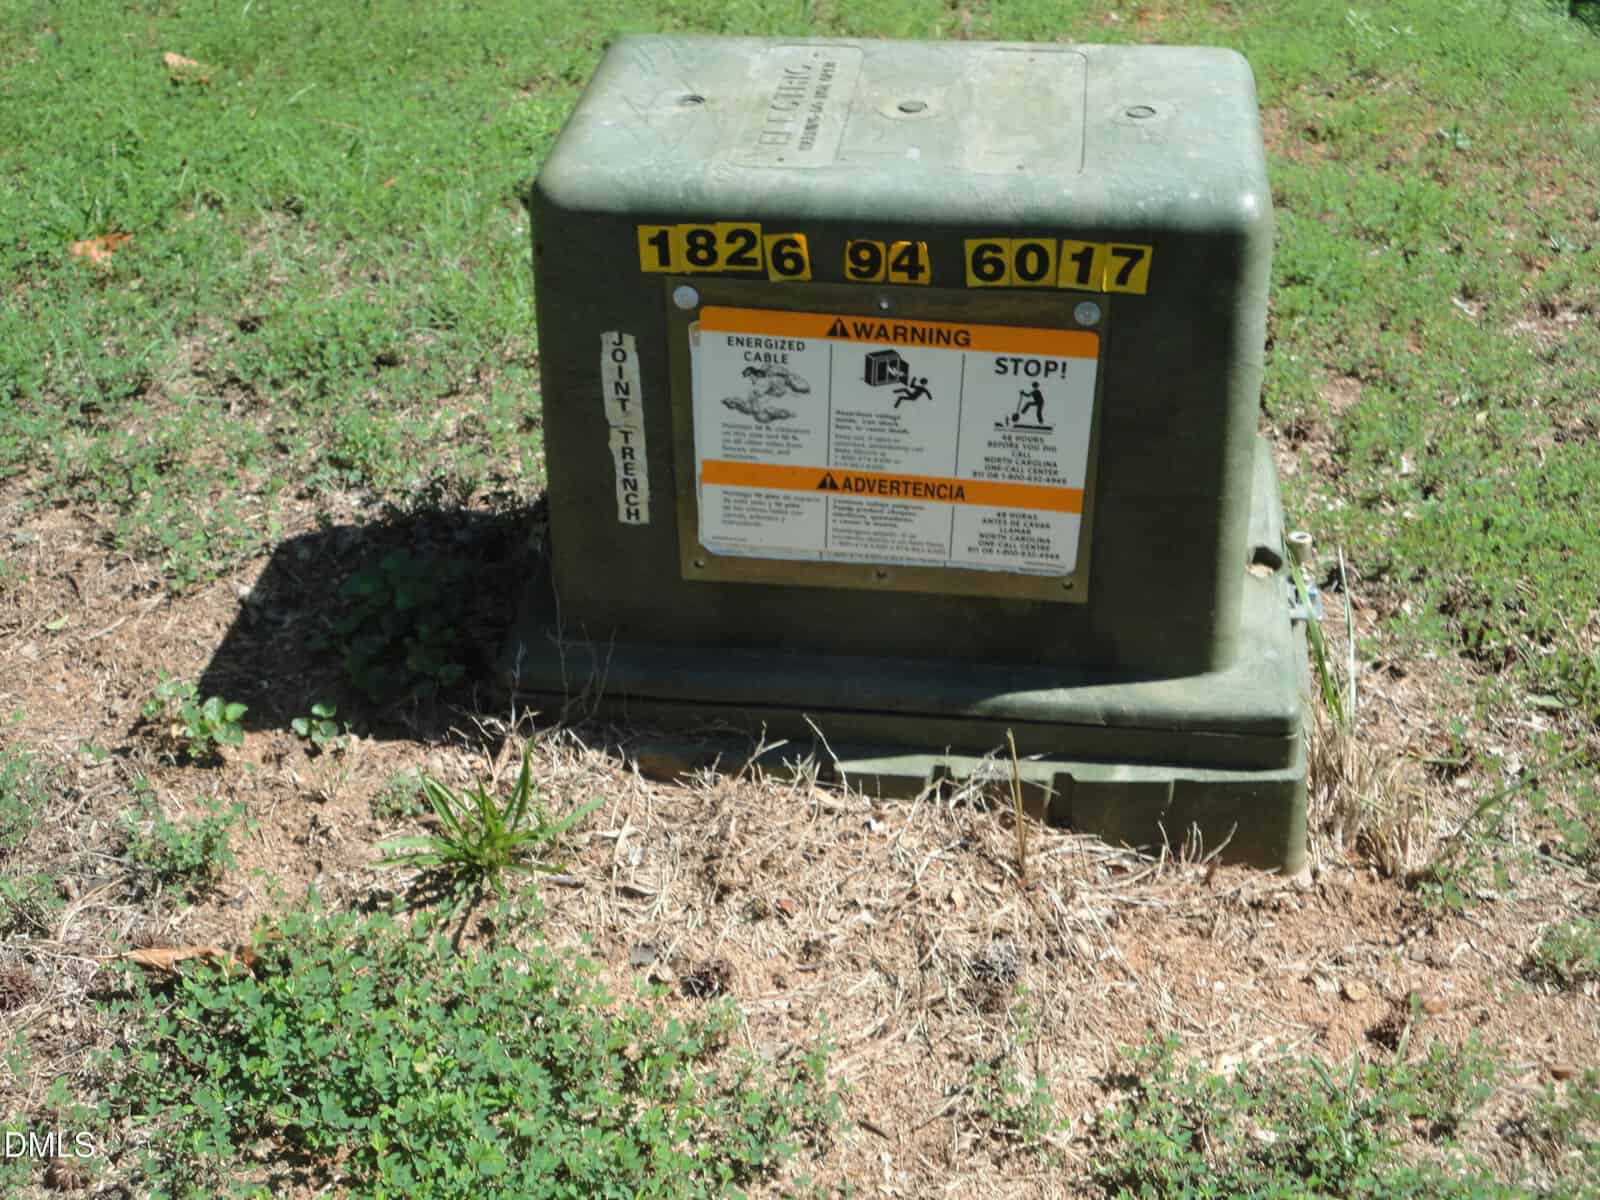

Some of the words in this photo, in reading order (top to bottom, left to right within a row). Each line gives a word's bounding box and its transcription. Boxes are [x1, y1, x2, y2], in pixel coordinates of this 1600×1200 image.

[646, 229, 806, 277] 1826
[848, 242, 926, 281] 94
[971, 243, 1145, 286] 6017
[854, 321, 971, 347] WARNING
[727, 335, 806, 352] ENERGIZED
[743, 351, 789, 364] CABLE
[611, 332, 631, 412] JOINT
[994, 356, 1067, 380] STOP!
[987, 440, 1019, 449] BEFORE
[1022, 443, 1041, 451] YOU
[1011, 450, 1031, 458] CALL
[984, 456, 1013, 465] NORTH
[1015, 458, 1057, 468] CAROLINA
[618, 430, 641, 521] TRENCH
[1027, 467, 1058, 476] CENTER
[844, 476, 966, 501] ADVERTENCIA
[1009, 512, 1038, 520] HORAS
[999, 527, 1031, 535] LLAMAR
[978, 532, 1007, 540] NORTH
[1009, 534, 1051, 544] CAROLINA
